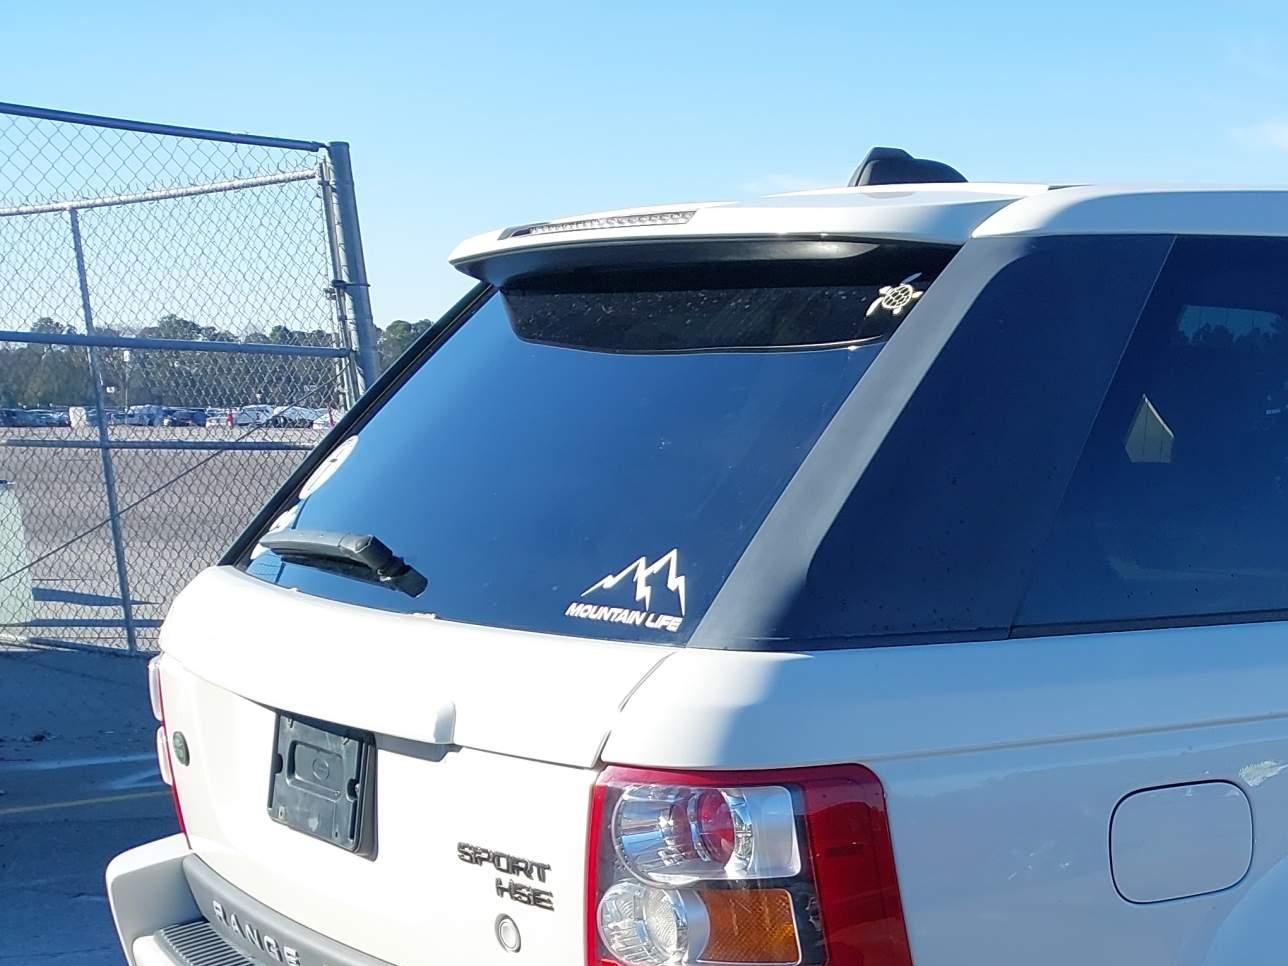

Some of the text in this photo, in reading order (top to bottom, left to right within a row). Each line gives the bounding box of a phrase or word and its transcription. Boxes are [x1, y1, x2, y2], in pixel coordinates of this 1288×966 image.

[565, 602, 684, 633] MOUNTAIN LIFE
[457, 842, 552, 883] SPORT
[496, 878, 555, 912] HSE
